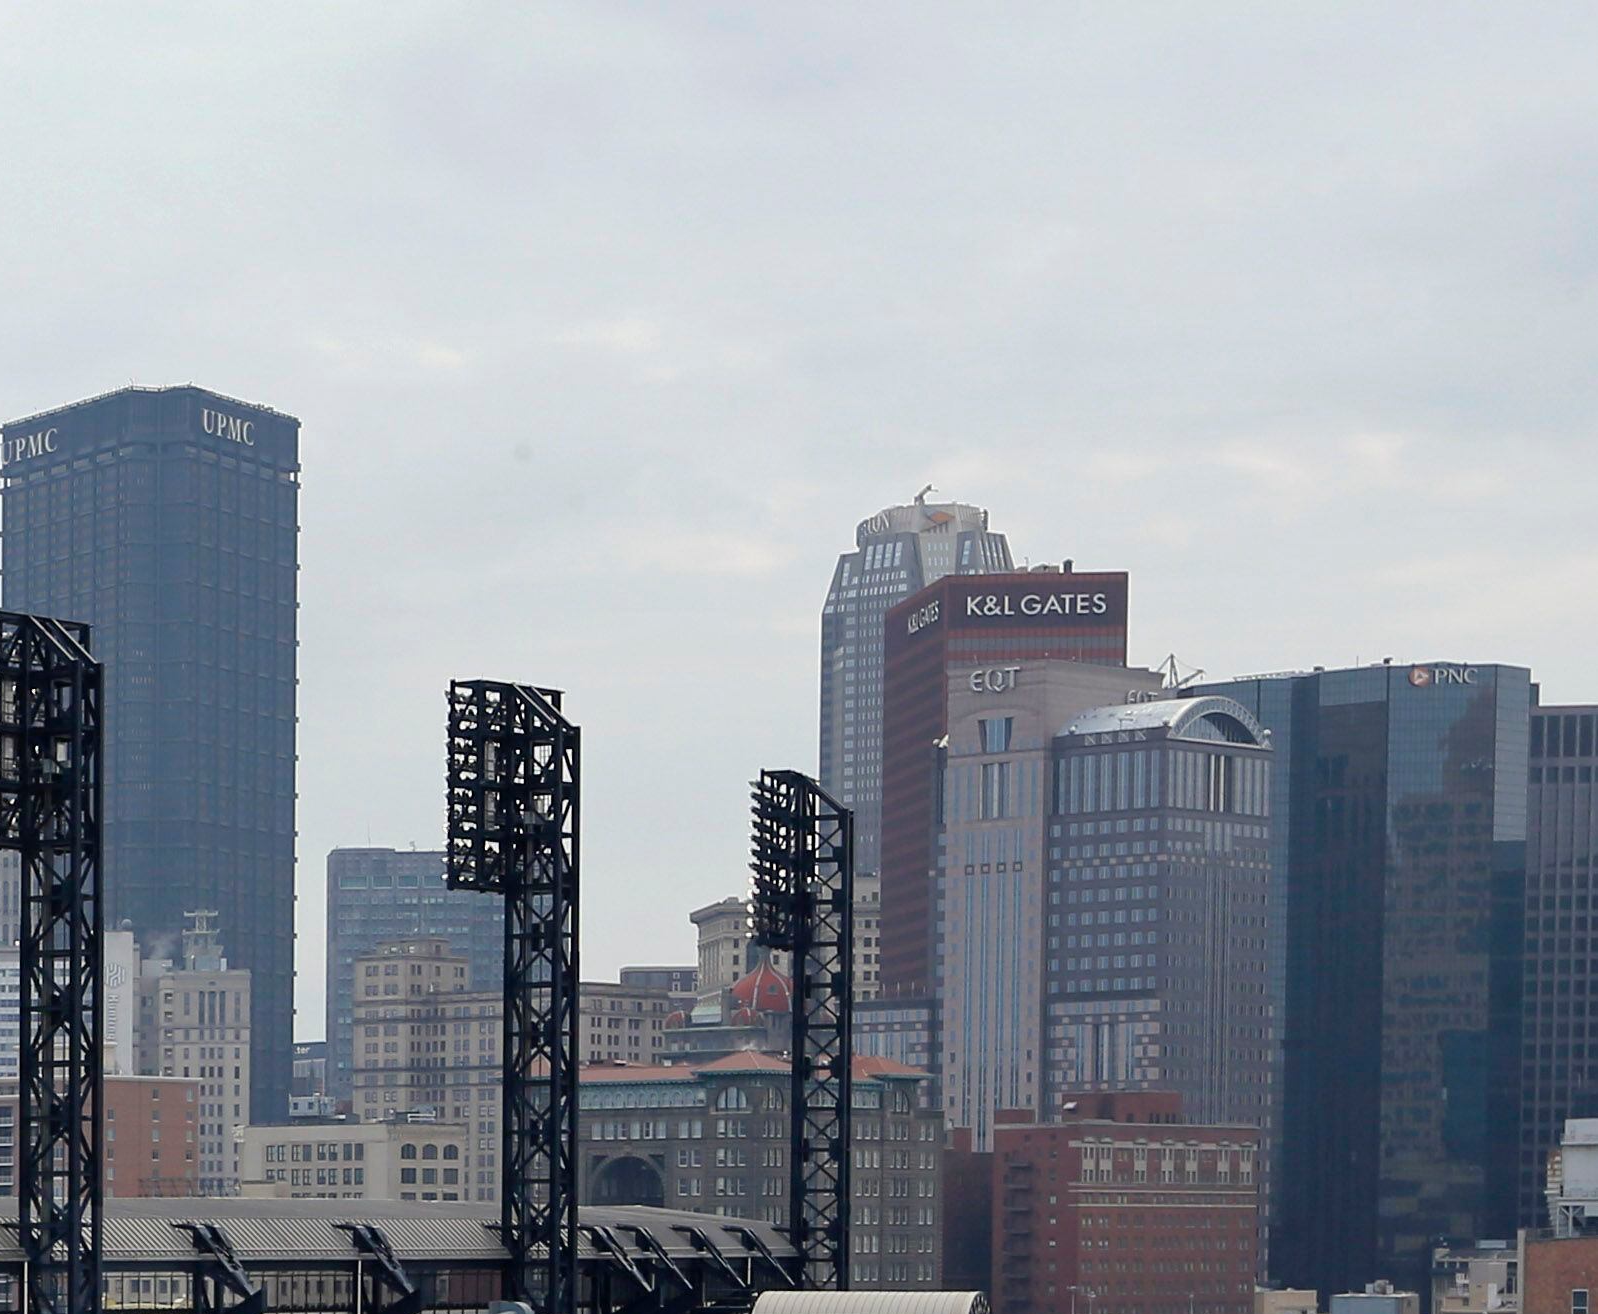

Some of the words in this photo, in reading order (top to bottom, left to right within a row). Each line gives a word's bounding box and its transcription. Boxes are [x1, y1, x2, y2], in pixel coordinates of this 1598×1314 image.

[201, 408, 254, 446] UPMC
[0, 428, 58, 465] UPMC
[919, 601, 940, 631] GATES
[967, 596, 1015, 616] K&L
[1020, 594, 1107, 615] GATES
[970, 666, 1020, 693] EQT
[1434, 668, 1478, 684] PNC
